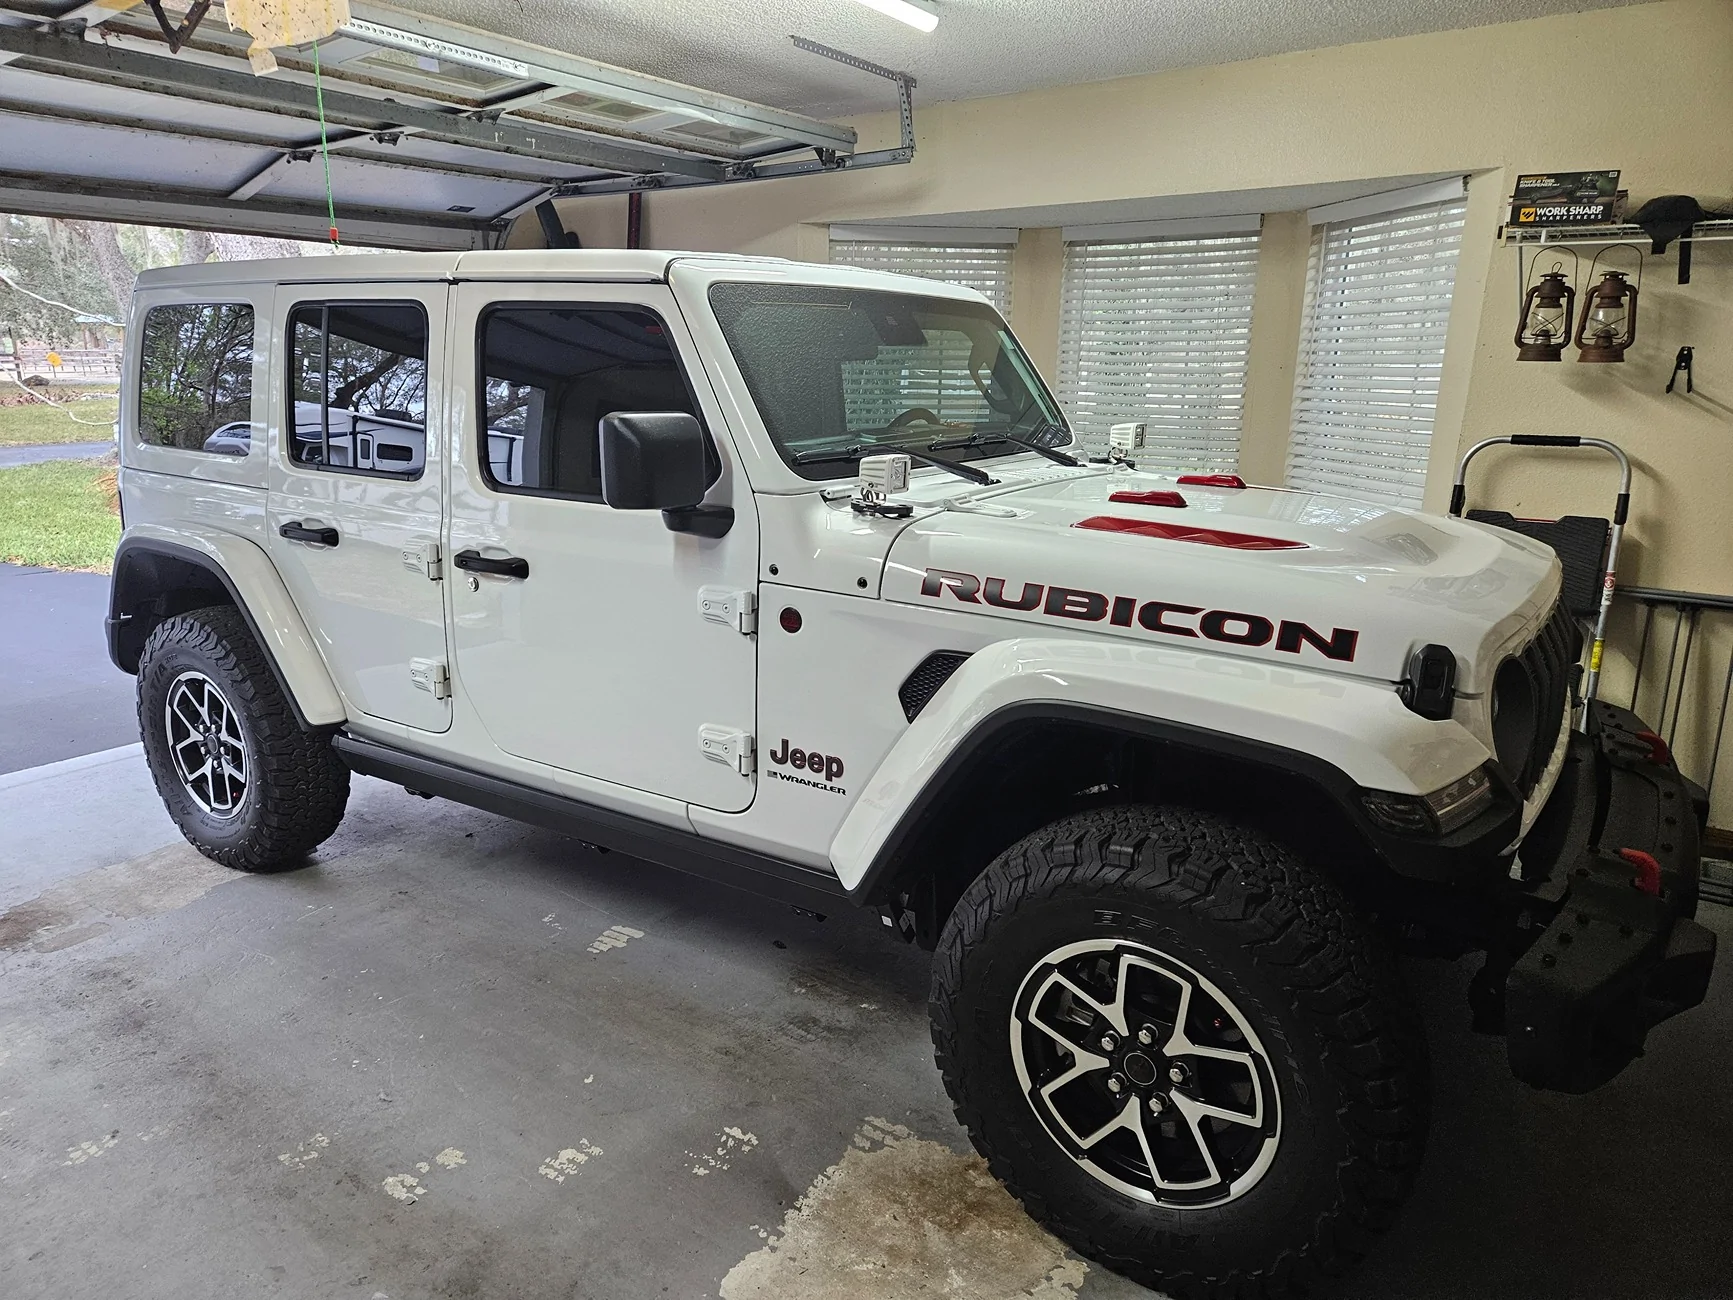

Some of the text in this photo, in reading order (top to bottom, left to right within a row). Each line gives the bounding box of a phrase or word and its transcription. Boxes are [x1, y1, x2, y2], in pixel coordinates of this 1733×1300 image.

[1536, 205, 1604, 216] WORK SHARP
[920, 568, 1359, 662] RUBICON
[769, 738, 844, 782] Jeep
[778, 772, 847, 796] WRANGLER
